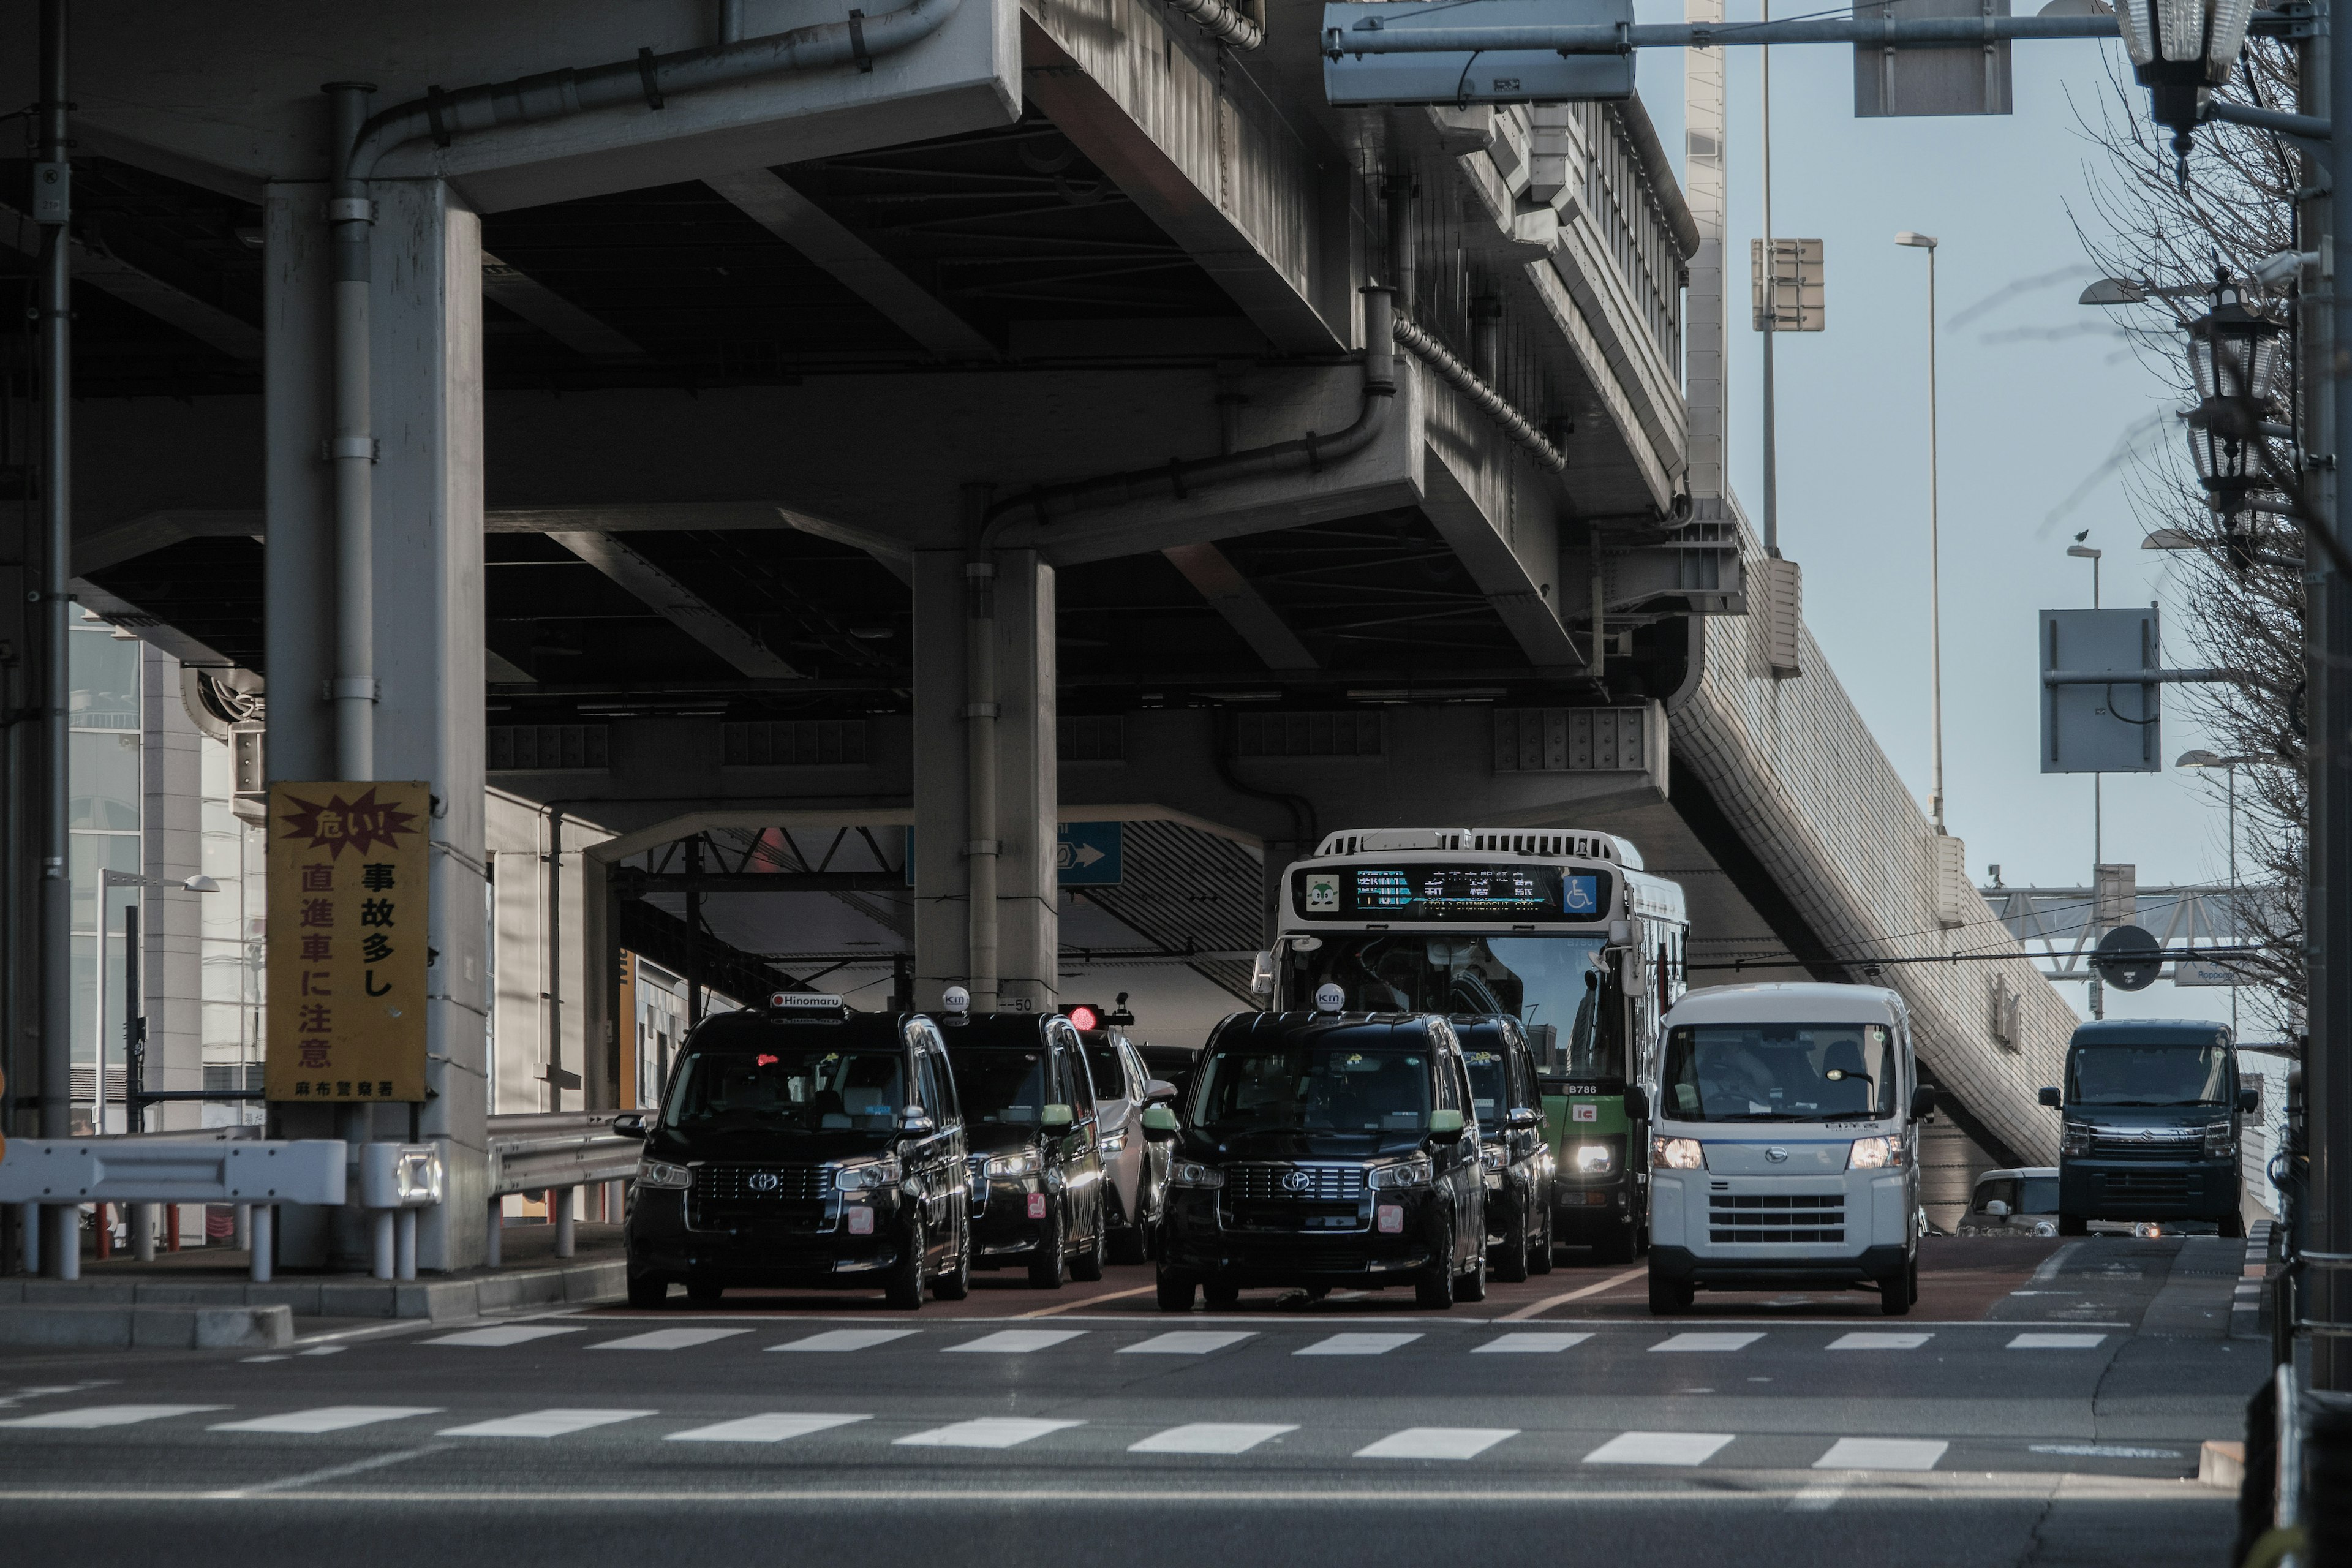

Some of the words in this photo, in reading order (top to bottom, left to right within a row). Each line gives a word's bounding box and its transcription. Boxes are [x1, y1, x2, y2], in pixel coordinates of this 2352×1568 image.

[314, 810, 385, 839] 危い!
[361, 863, 396, 998] 事故多し
[298, 863, 335, 1069] 直進車に注意
[785, 995, 839, 1005] Hinomaru
[295, 1080, 393, 1097] 麻布警察署
[1569, 1085, 1597, 1095] B786
